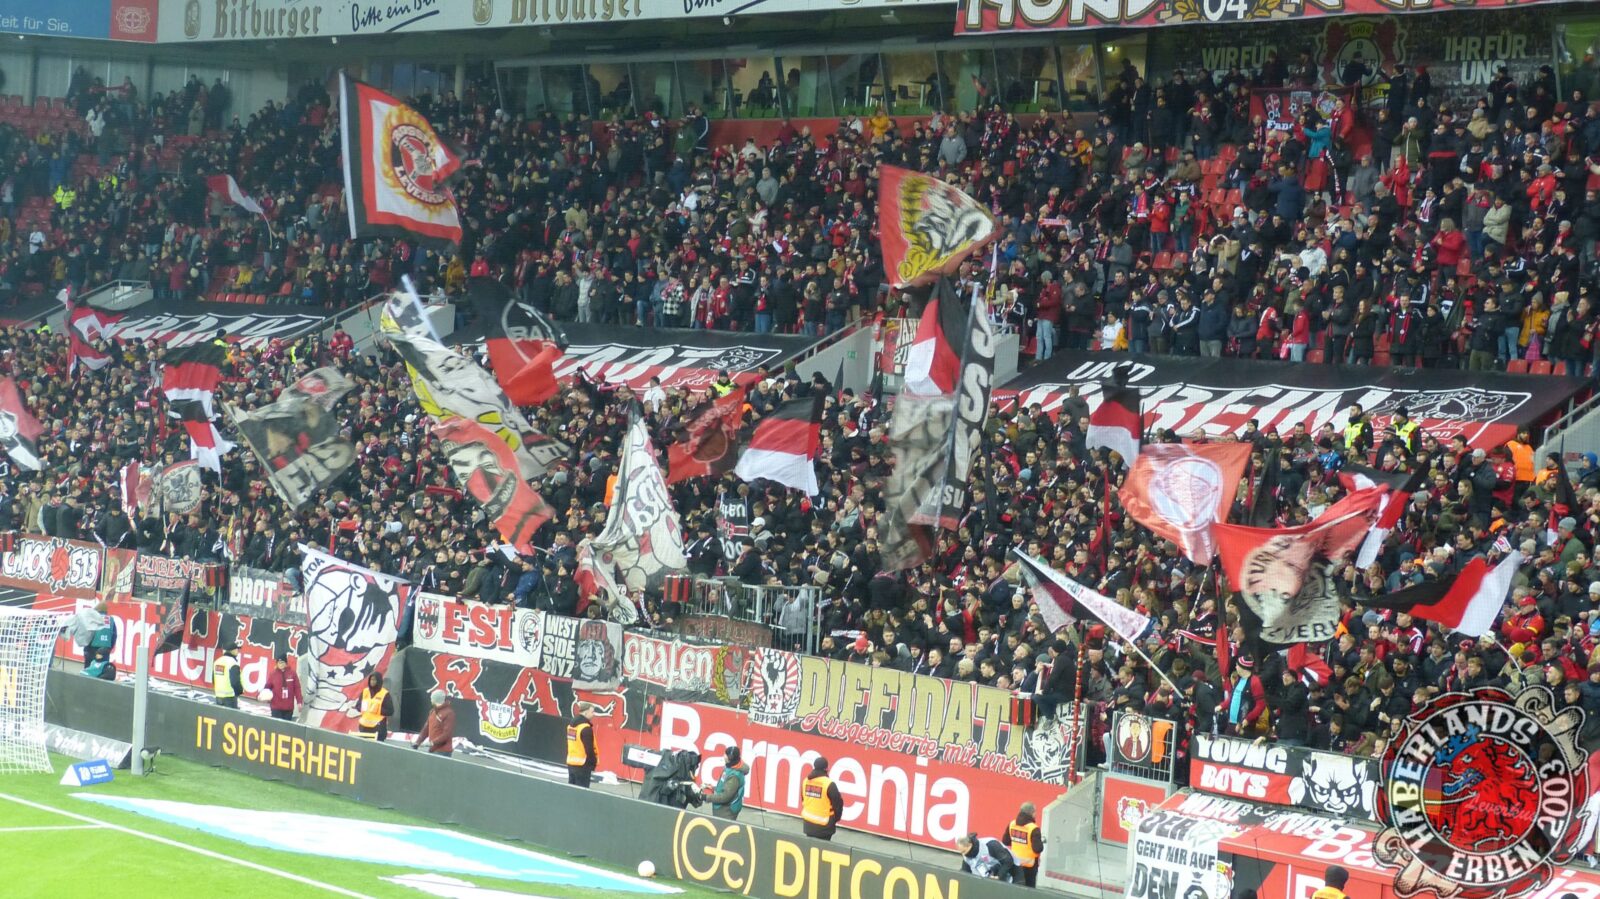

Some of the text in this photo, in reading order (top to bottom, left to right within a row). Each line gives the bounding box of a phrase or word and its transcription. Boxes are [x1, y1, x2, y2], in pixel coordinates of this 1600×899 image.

[0, 14, 72, 32] eit für Sie.
[213, 0, 322, 37] Bitburger
[352, 3, 383, 32] Bitte
[387, 0, 411, 19] ein
[1202, 48, 1242, 71] WIR
[1444, 34, 1527, 62] IHR FÜR
[1461, 61, 1504, 87] UNS
[230, 576, 277, 608] BROT
[441, 600, 514, 652] FSI
[545, 614, 578, 640] WEST
[543, 634, 576, 660] SIDE
[542, 653, 575, 679] BOYZ
[196, 715, 363, 786] IT SICHERHEIT
[800, 707, 938, 759] Ausgesperrte
[943, 742, 978, 768] mit
[1195, 733, 1289, 773] YOUNG
[658, 700, 970, 844] Barmenia
[1200, 763, 1270, 798] BOYS
[773, 838, 960, 899] DITCON
[1136, 838, 1216, 871] GEHT MIR AUF
[1130, 861, 1180, 899] DEN
